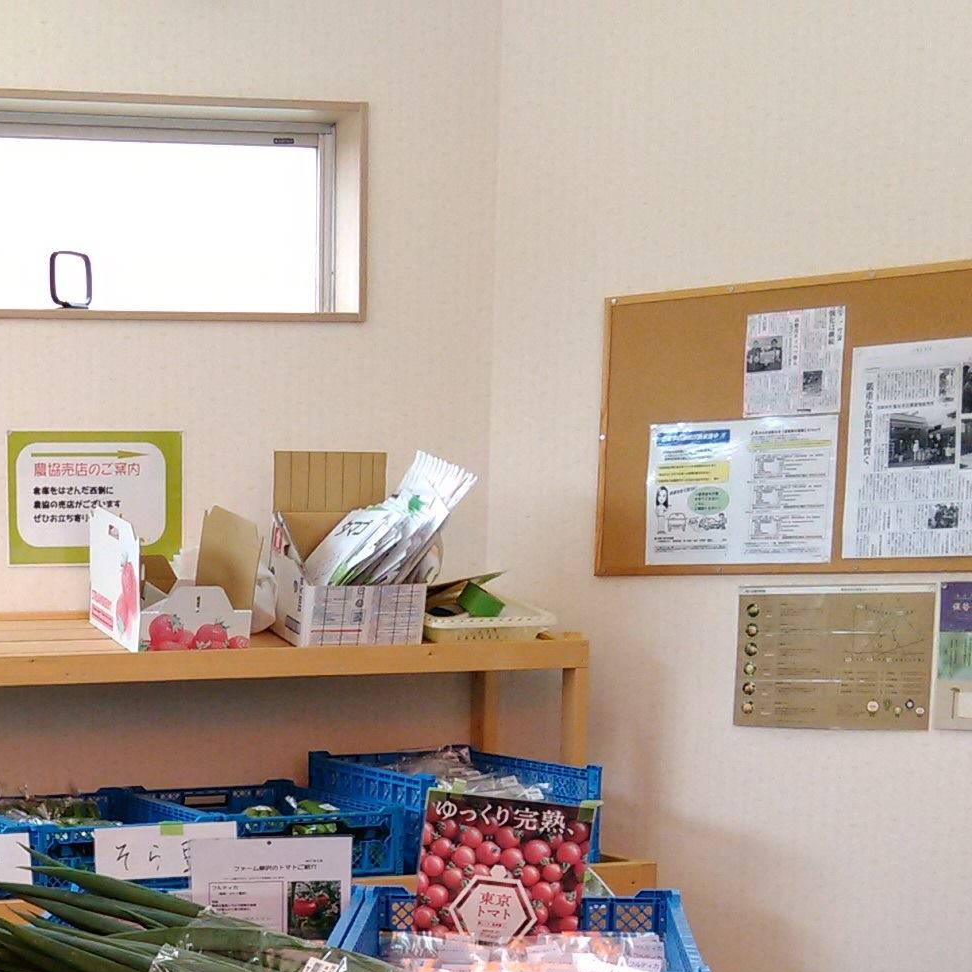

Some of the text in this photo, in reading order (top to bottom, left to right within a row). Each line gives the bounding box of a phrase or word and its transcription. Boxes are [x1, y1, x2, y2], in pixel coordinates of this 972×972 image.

[34, 462, 141, 477] 農協売店のご案内
[33, 500, 121, 509] 農協の売店がございます
[33, 511, 122, 523] ぜひお立ち寄り
[435, 799, 574, 836] ゆっくり完熟、
[480, 892, 512, 907] 東京
[478, 905, 511, 920] トマト
